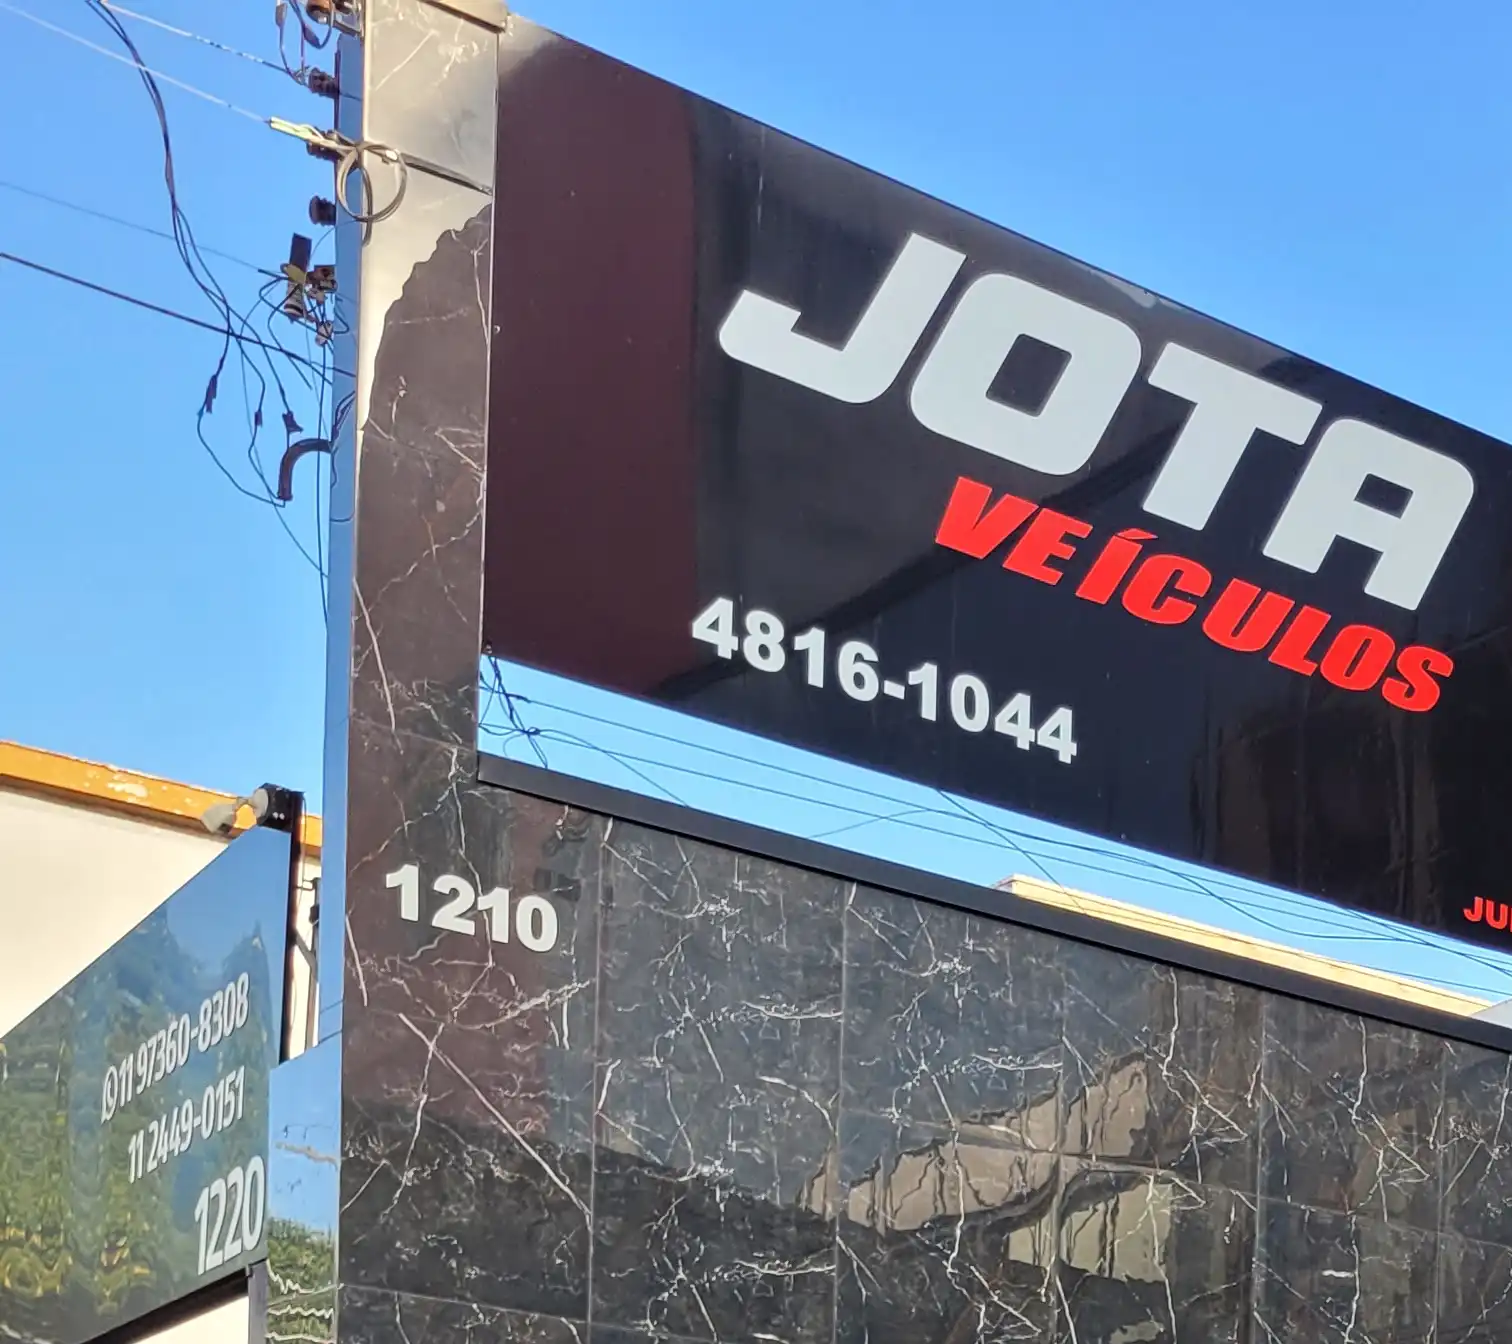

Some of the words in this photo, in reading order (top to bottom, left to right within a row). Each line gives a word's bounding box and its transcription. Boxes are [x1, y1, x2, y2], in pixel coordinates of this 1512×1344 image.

[718, 231, 1475, 612] JOTA
[933, 475, 1456, 714] VEÍCULOS
[689, 596, 1079, 765] 4816-1044
[384, 865, 559, 954] 1210
[136, 971, 250, 1095] 97360-8308
[146, 1064, 246, 1174] 2449-0151
[194, 1154, 267, 1276] 1220
